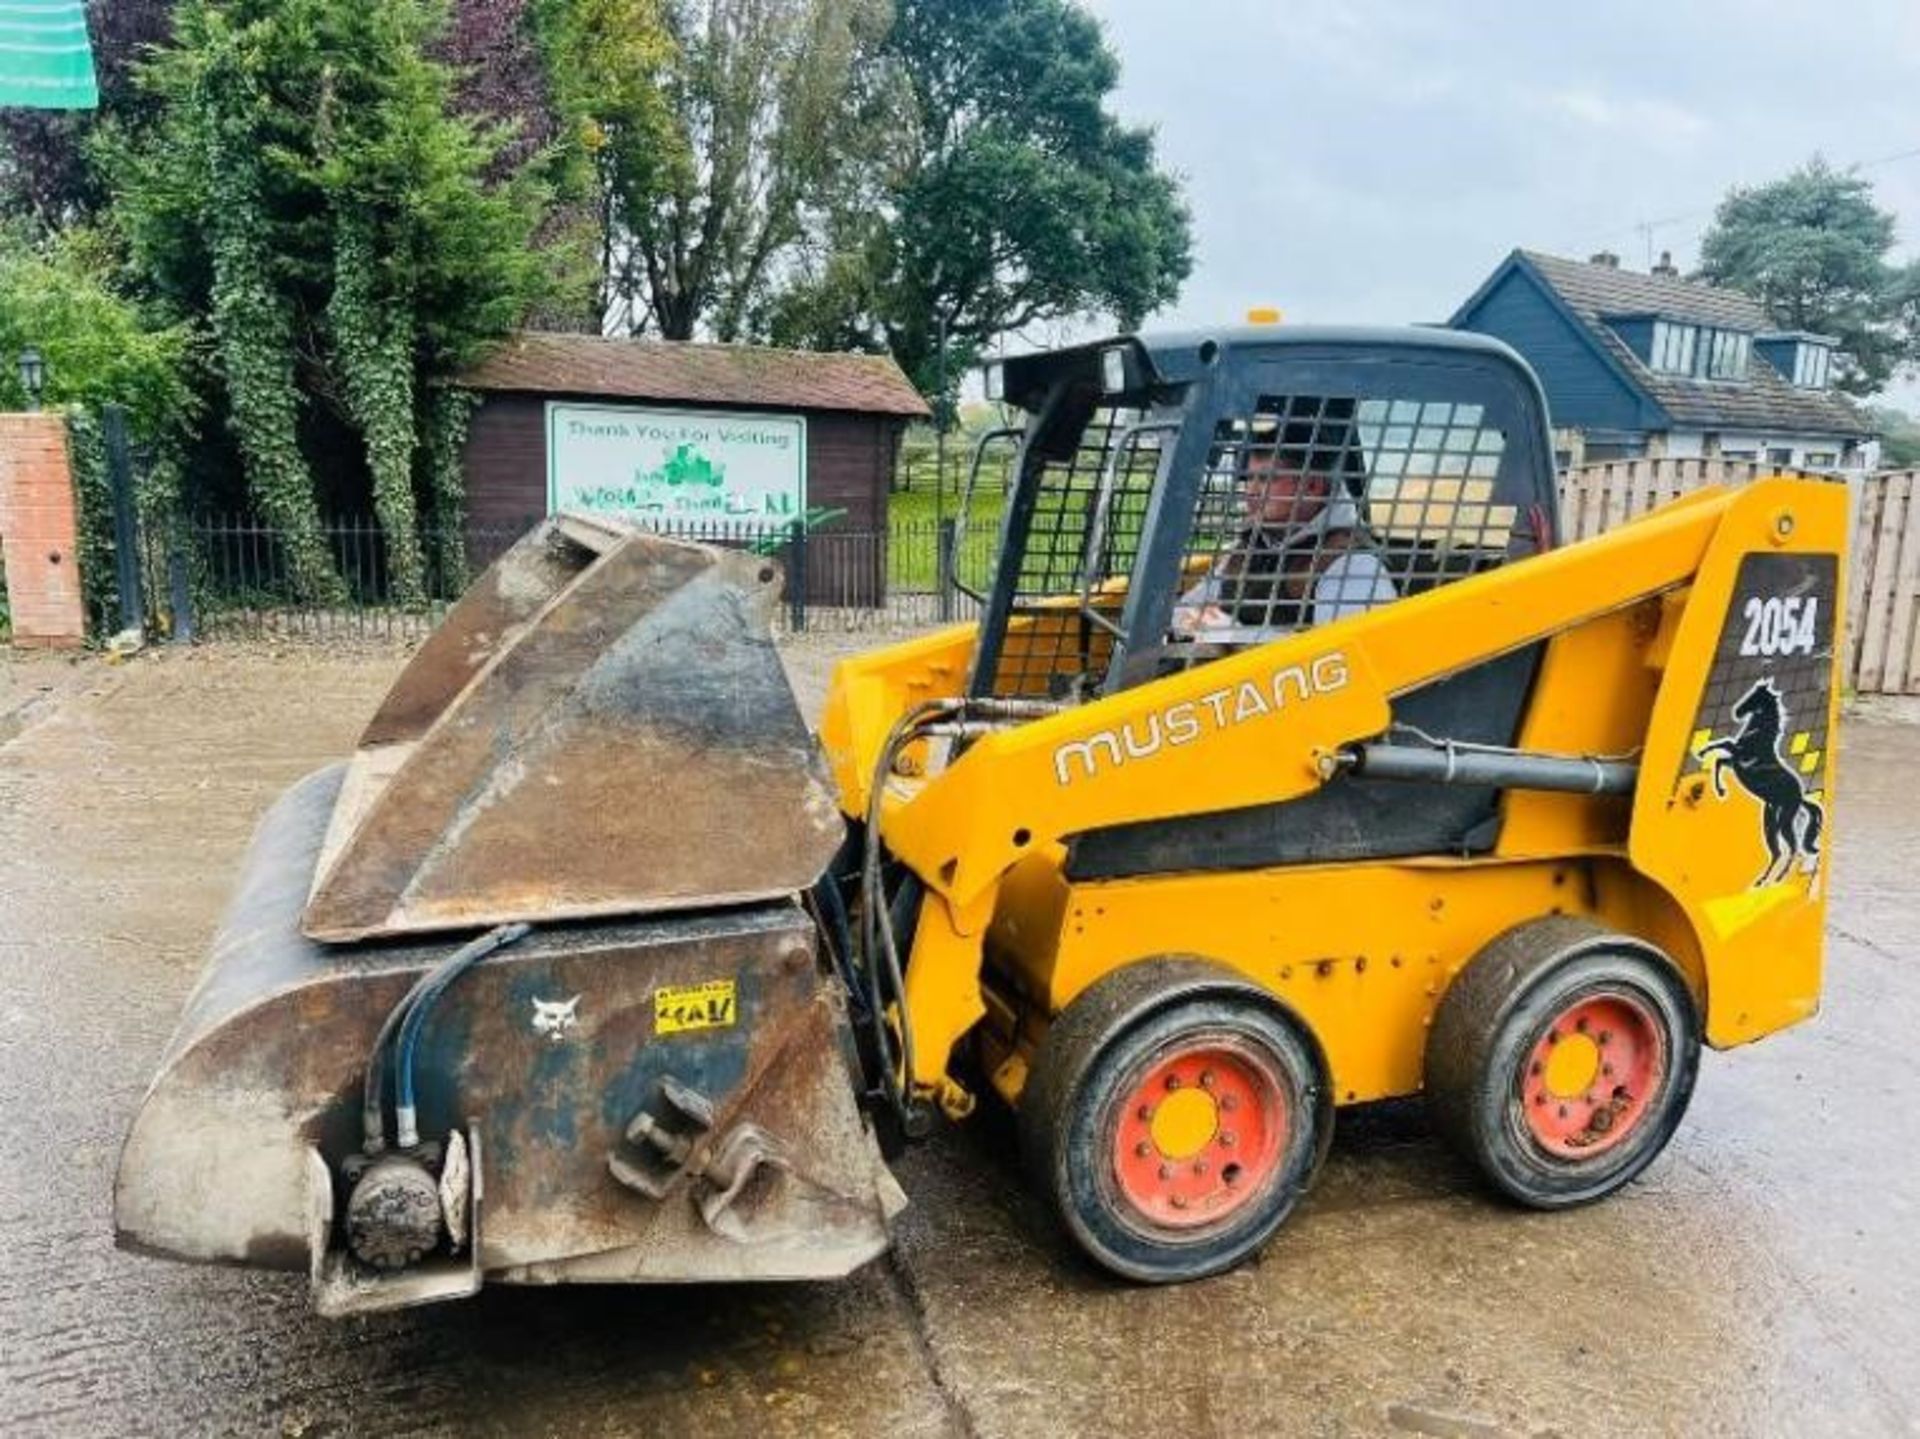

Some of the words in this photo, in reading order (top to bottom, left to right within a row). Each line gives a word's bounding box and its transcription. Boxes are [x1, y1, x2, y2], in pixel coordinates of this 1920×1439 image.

[568, 420, 631, 438] Thank
[717, 427, 790, 450] Visiting
[1739, 596, 1818, 657] 2054
[1054, 652, 1348, 786] MUSTANG
